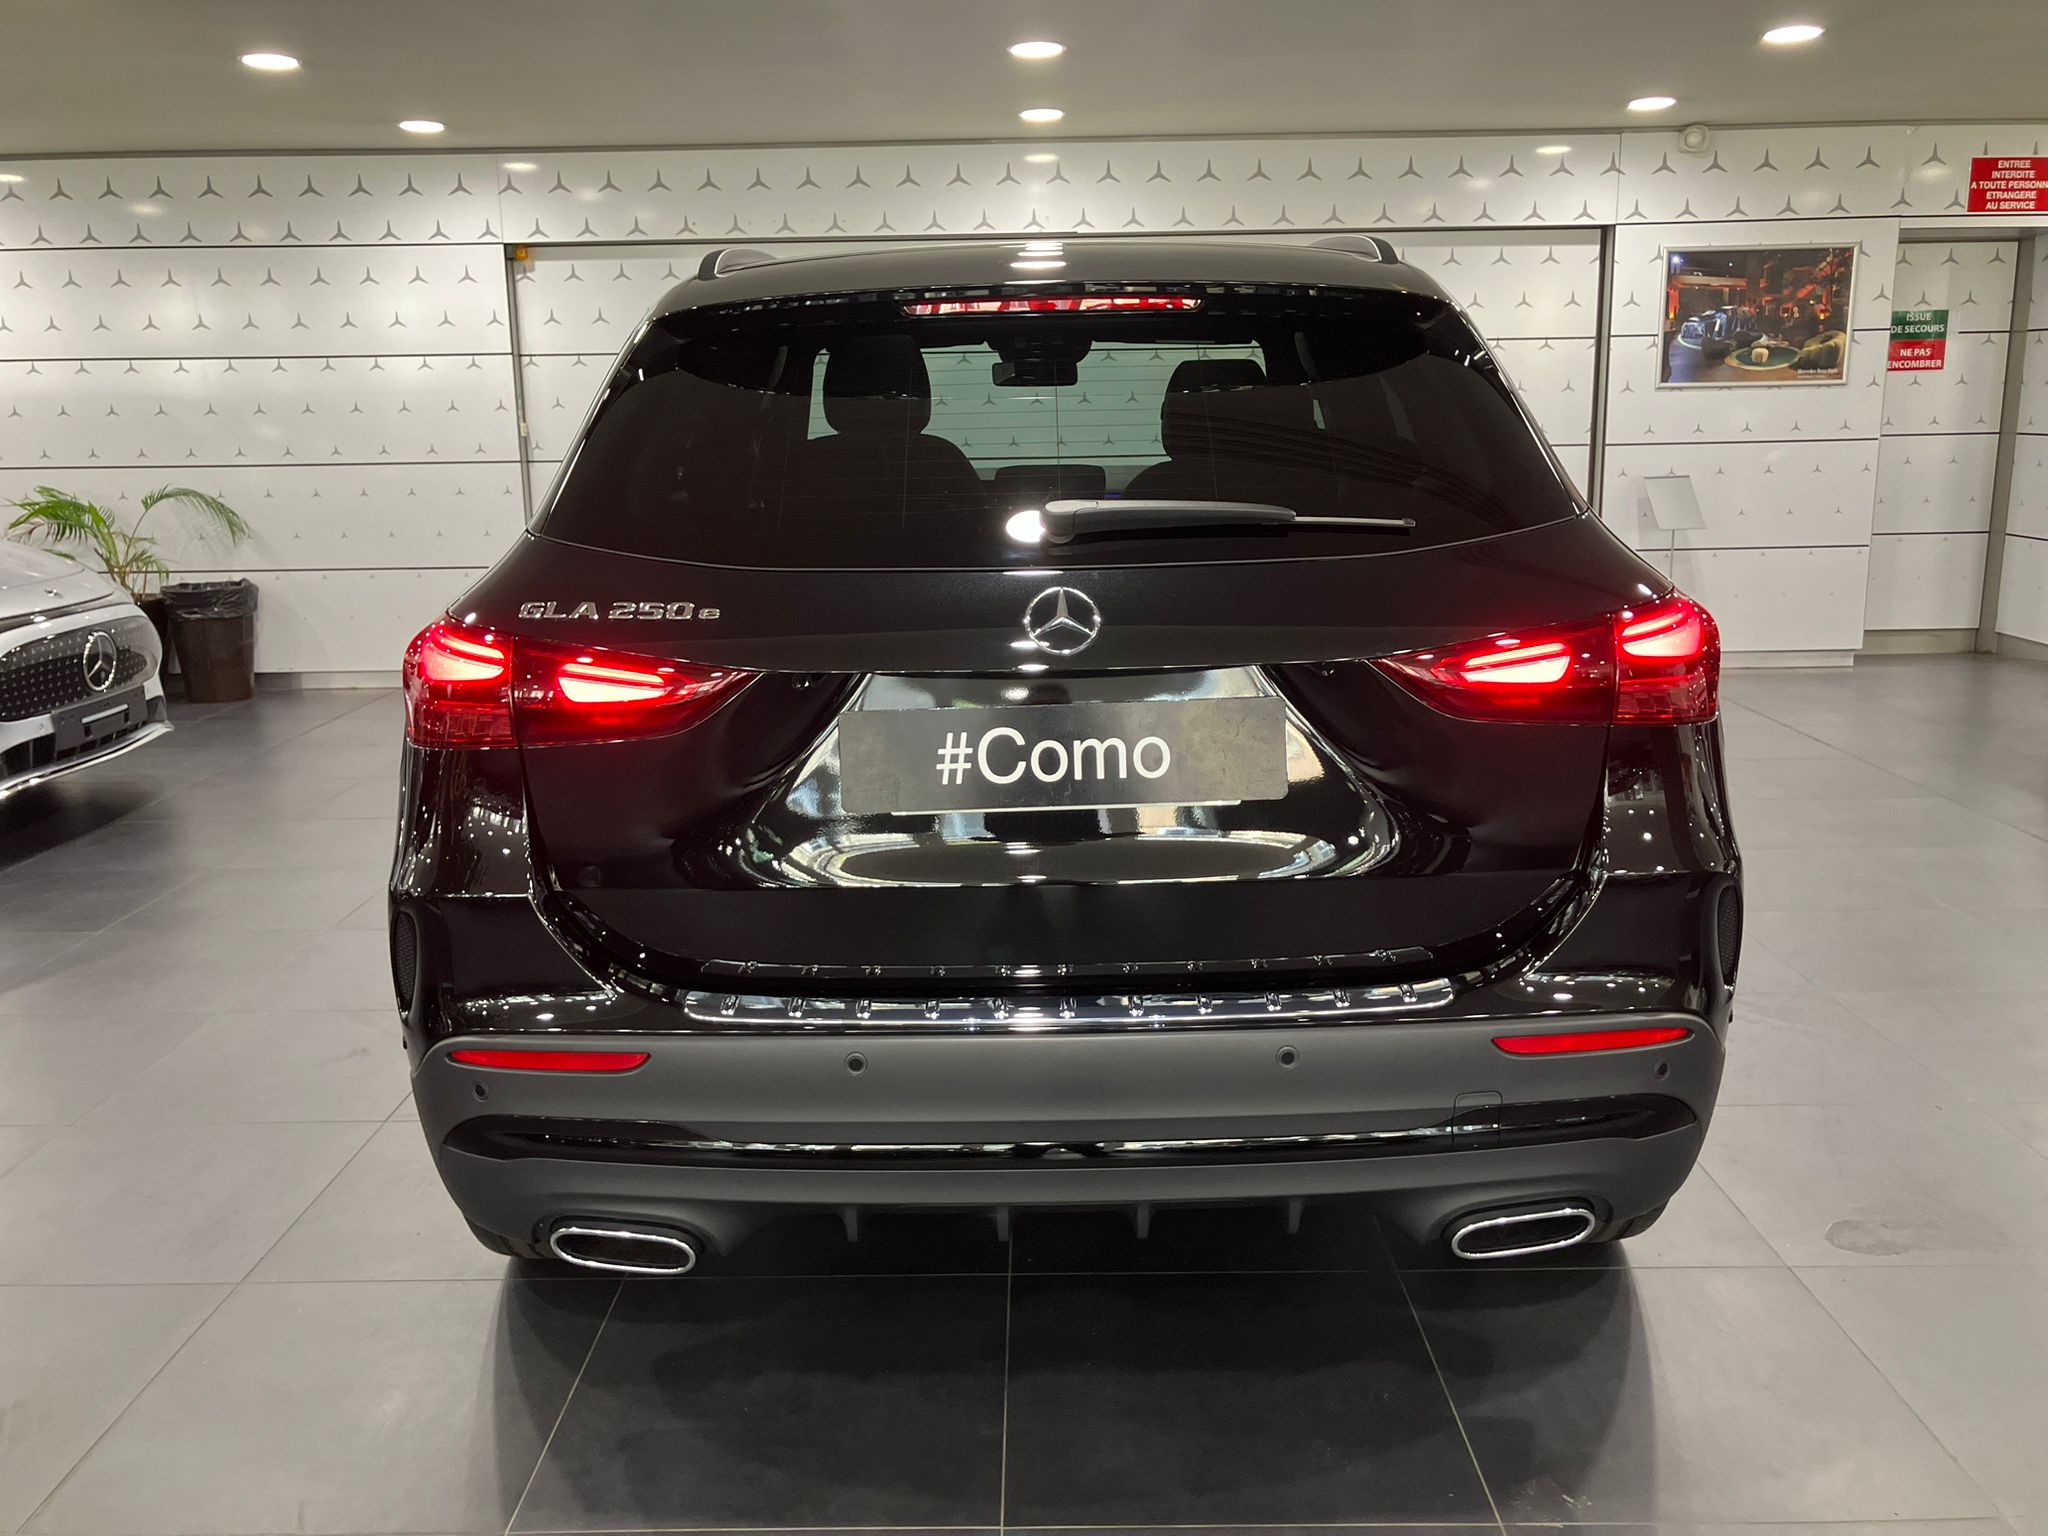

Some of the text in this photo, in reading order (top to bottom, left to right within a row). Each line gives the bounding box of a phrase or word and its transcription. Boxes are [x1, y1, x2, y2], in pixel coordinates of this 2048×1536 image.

[1998, 160, 2031, 169] ENTREE
[1991, 170, 2036, 179] INTERDITE
[1971, 181, 1977, 189] A
[1979, 181, 2007, 189] TOUTE
[1986, 190, 2037, 199] ETRANGERE
[1985, 201, 2036, 210] AU SERVICE
[1906, 312, 1932, 321] ISSUE
[1890, 324, 1945, 334] DE SECOURS
[1900, 348, 1932, 357] NE PAS
[1887, 359, 1942, 369] ENCOMBRER
[518, 601, 599, 619] GLA
[936, 726, 1171, 785] #Como
